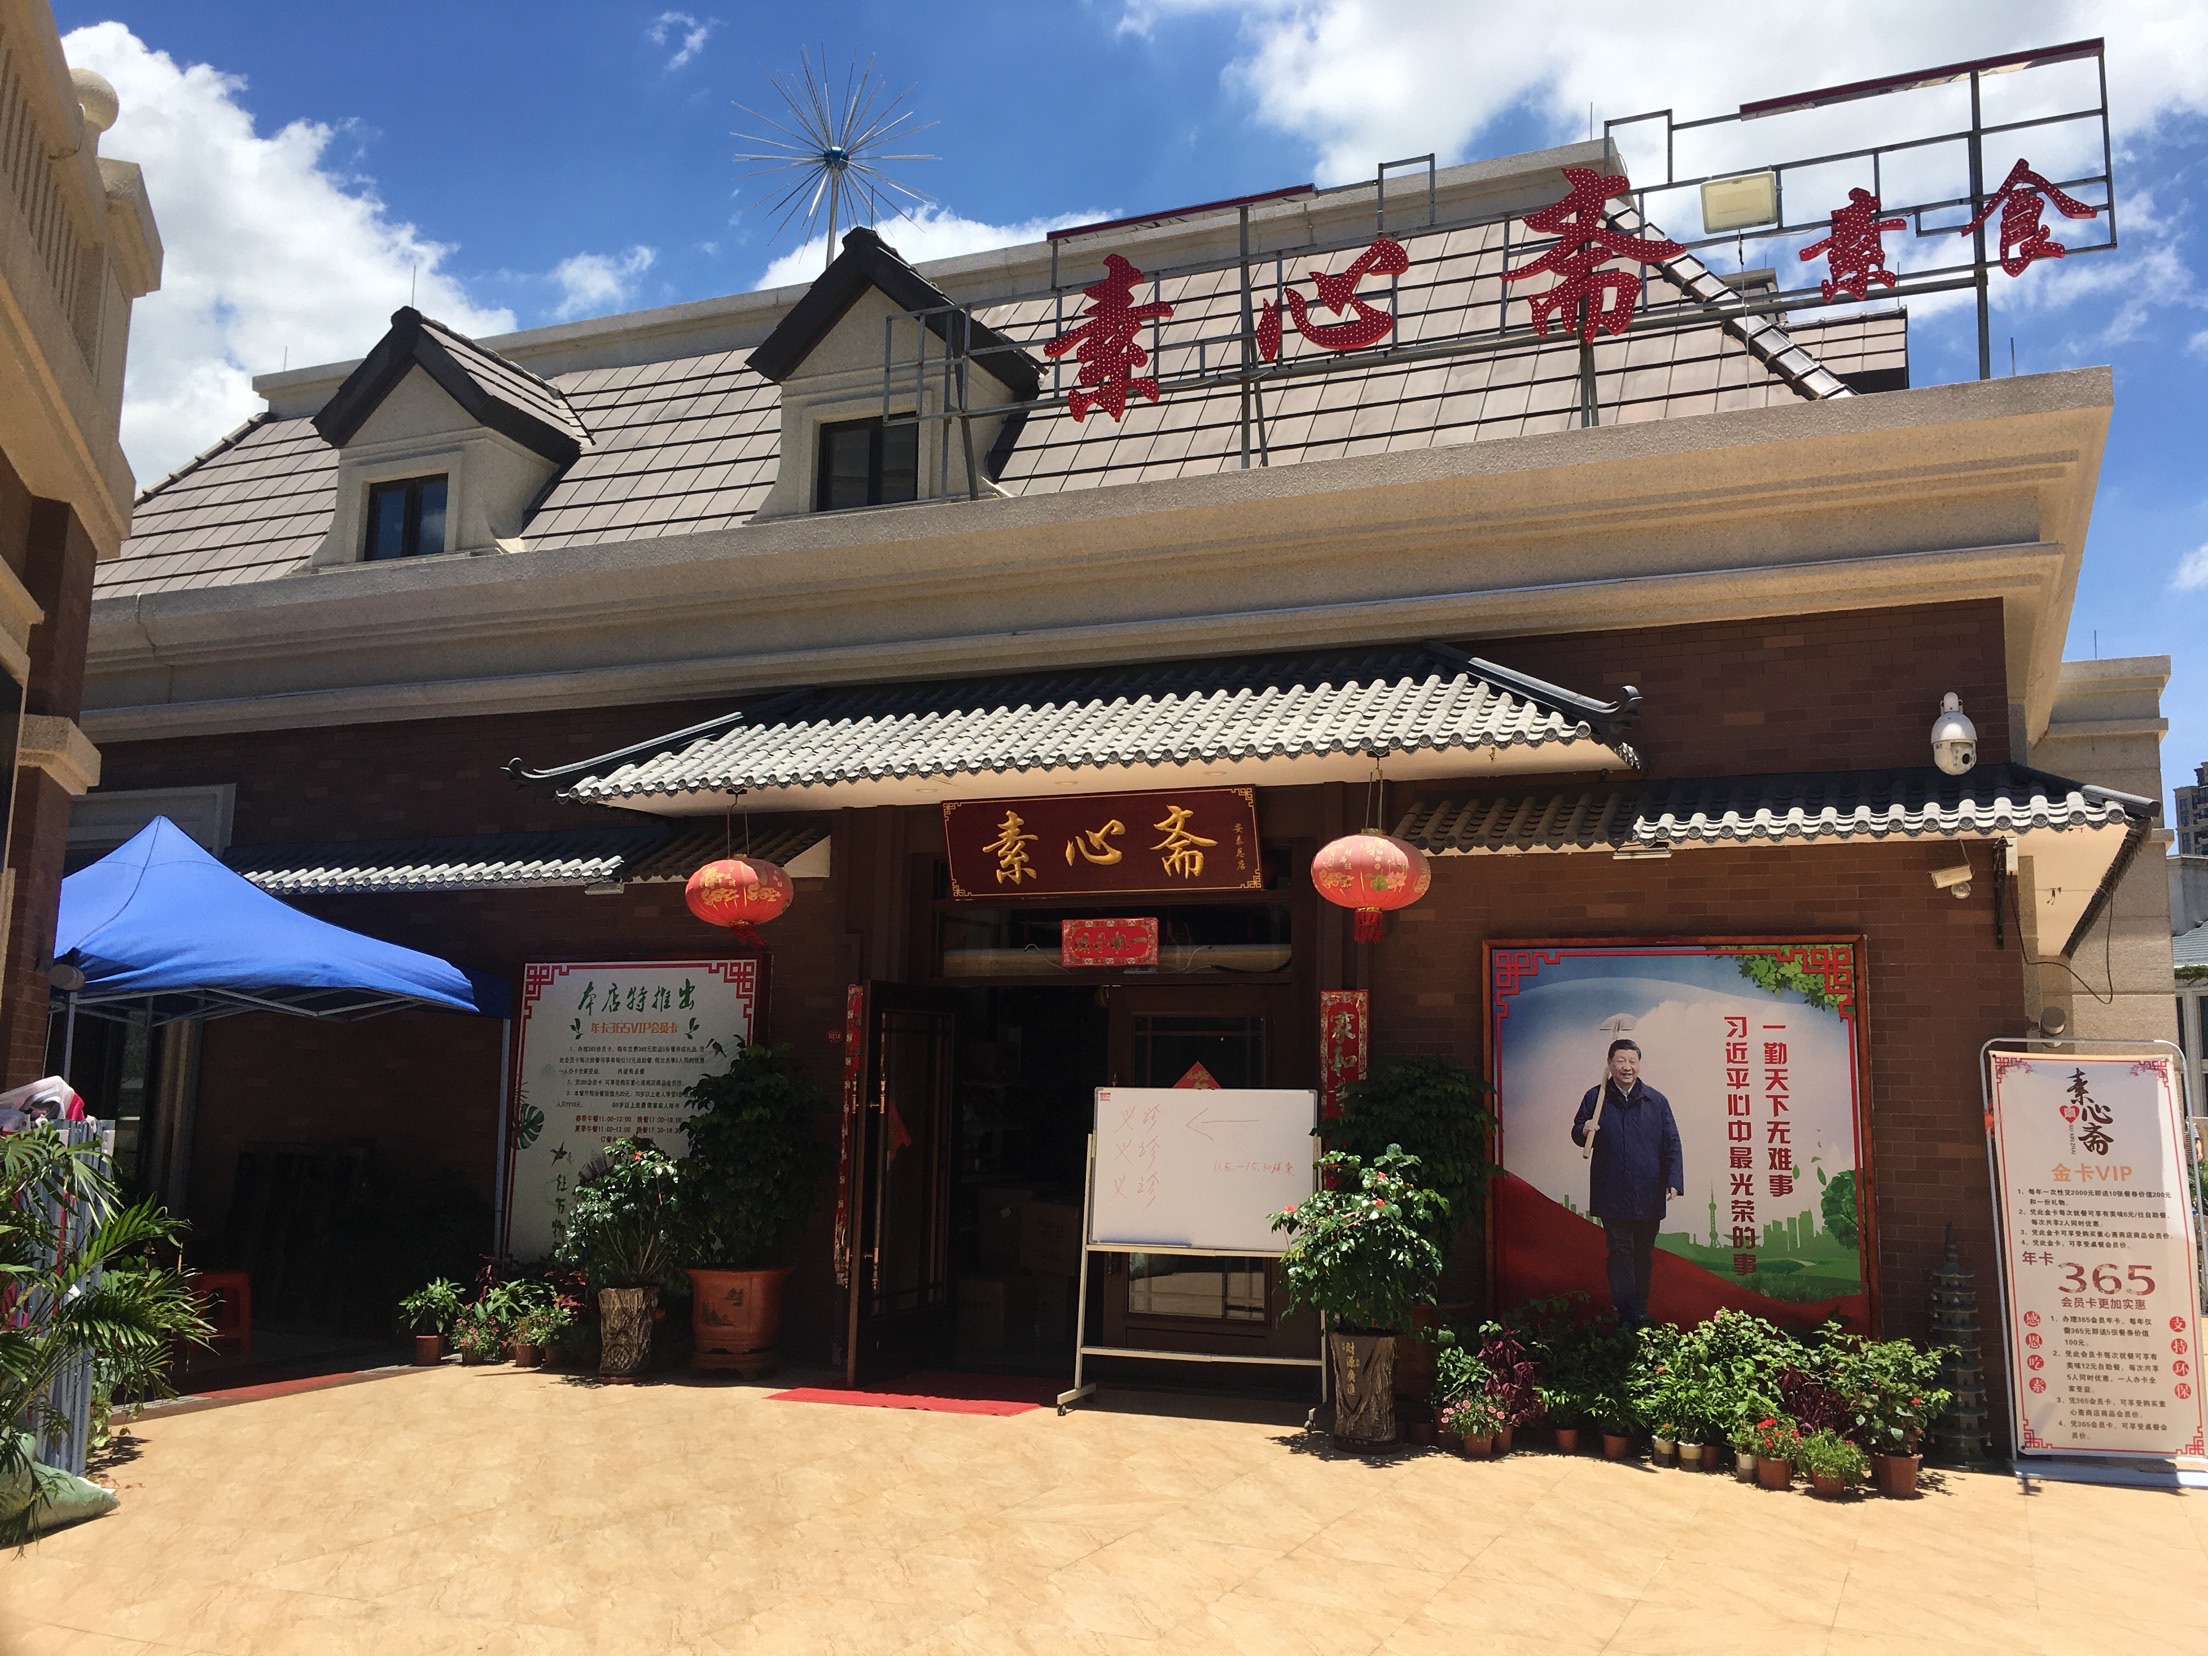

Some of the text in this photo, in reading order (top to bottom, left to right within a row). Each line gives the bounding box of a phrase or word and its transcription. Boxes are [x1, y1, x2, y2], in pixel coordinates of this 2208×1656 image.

[1043, 157, 2098, 424] 素心斋 素食
[982, 805, 1218, 885] 素心斋
[577, 978, 696, 1015] 本店特推出
[591, 1022, 678, 1034] 年卡365VIP会员卡
[1723, 1016, 1757, 1276] 习近平心中最光荣的事
[1762, 1024, 1793, 1198] 一勤天下无难事
[2067, 1067, 2114, 1156] 素心斋
[2052, 1163, 2133, 1182] 金卡VIP
[2022, 1251, 2054, 1266] 年卡
[2057, 1262, 2156, 1296] 365
[2061, 1297, 2147, 1311] 会员卡更加实惠
[2024, 1312, 2046, 1393] 感恩吃素
[2170, 1317, 2190, 1398] 支持环保
